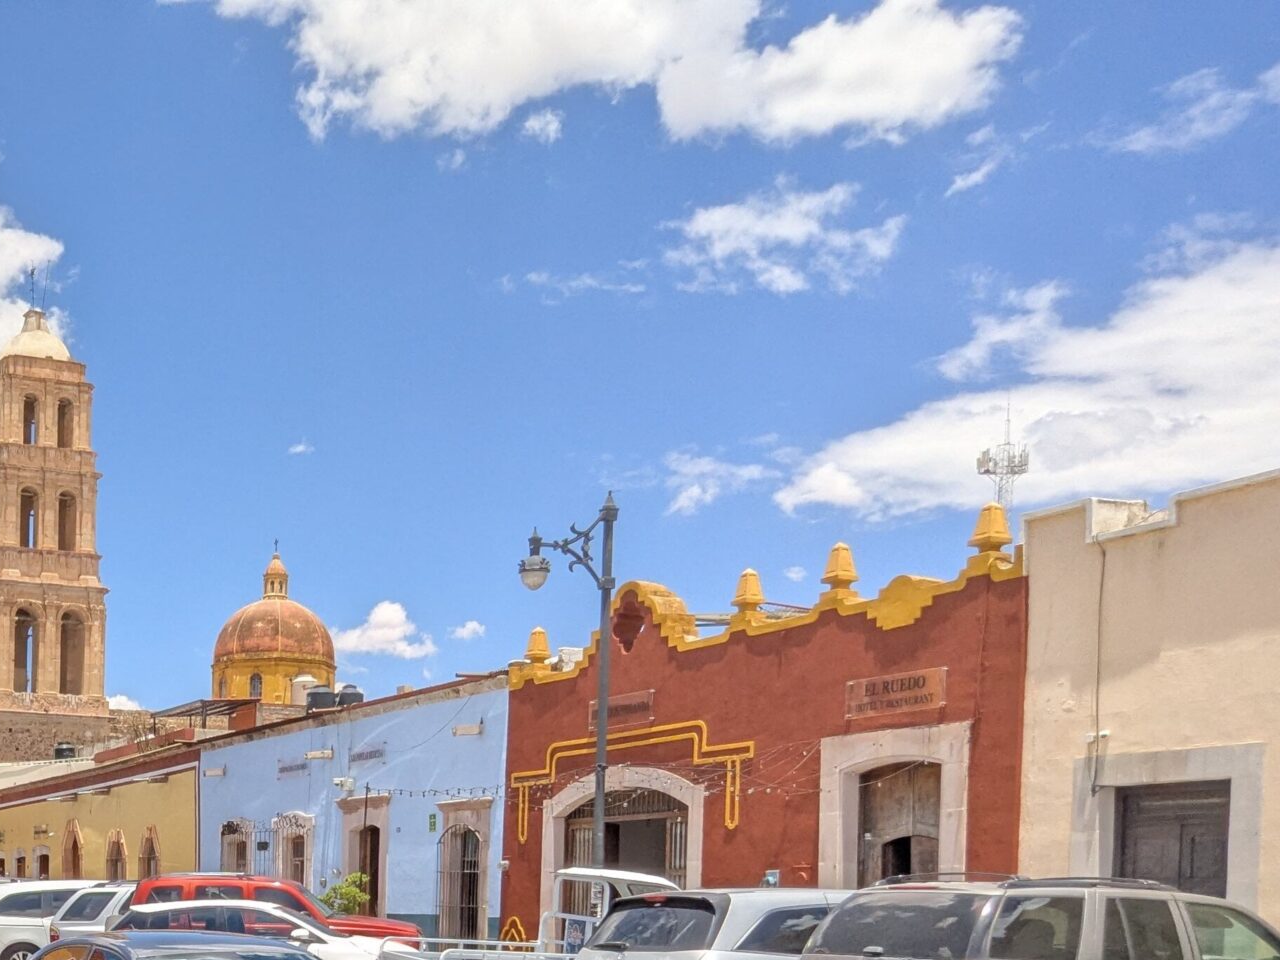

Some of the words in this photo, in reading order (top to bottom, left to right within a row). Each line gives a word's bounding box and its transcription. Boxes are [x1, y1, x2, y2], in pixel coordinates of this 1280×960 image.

[864, 683, 879, 697] EL
[881, 675, 926, 695] RUEDO
[884, 692, 934, 709] RESTAURANT
